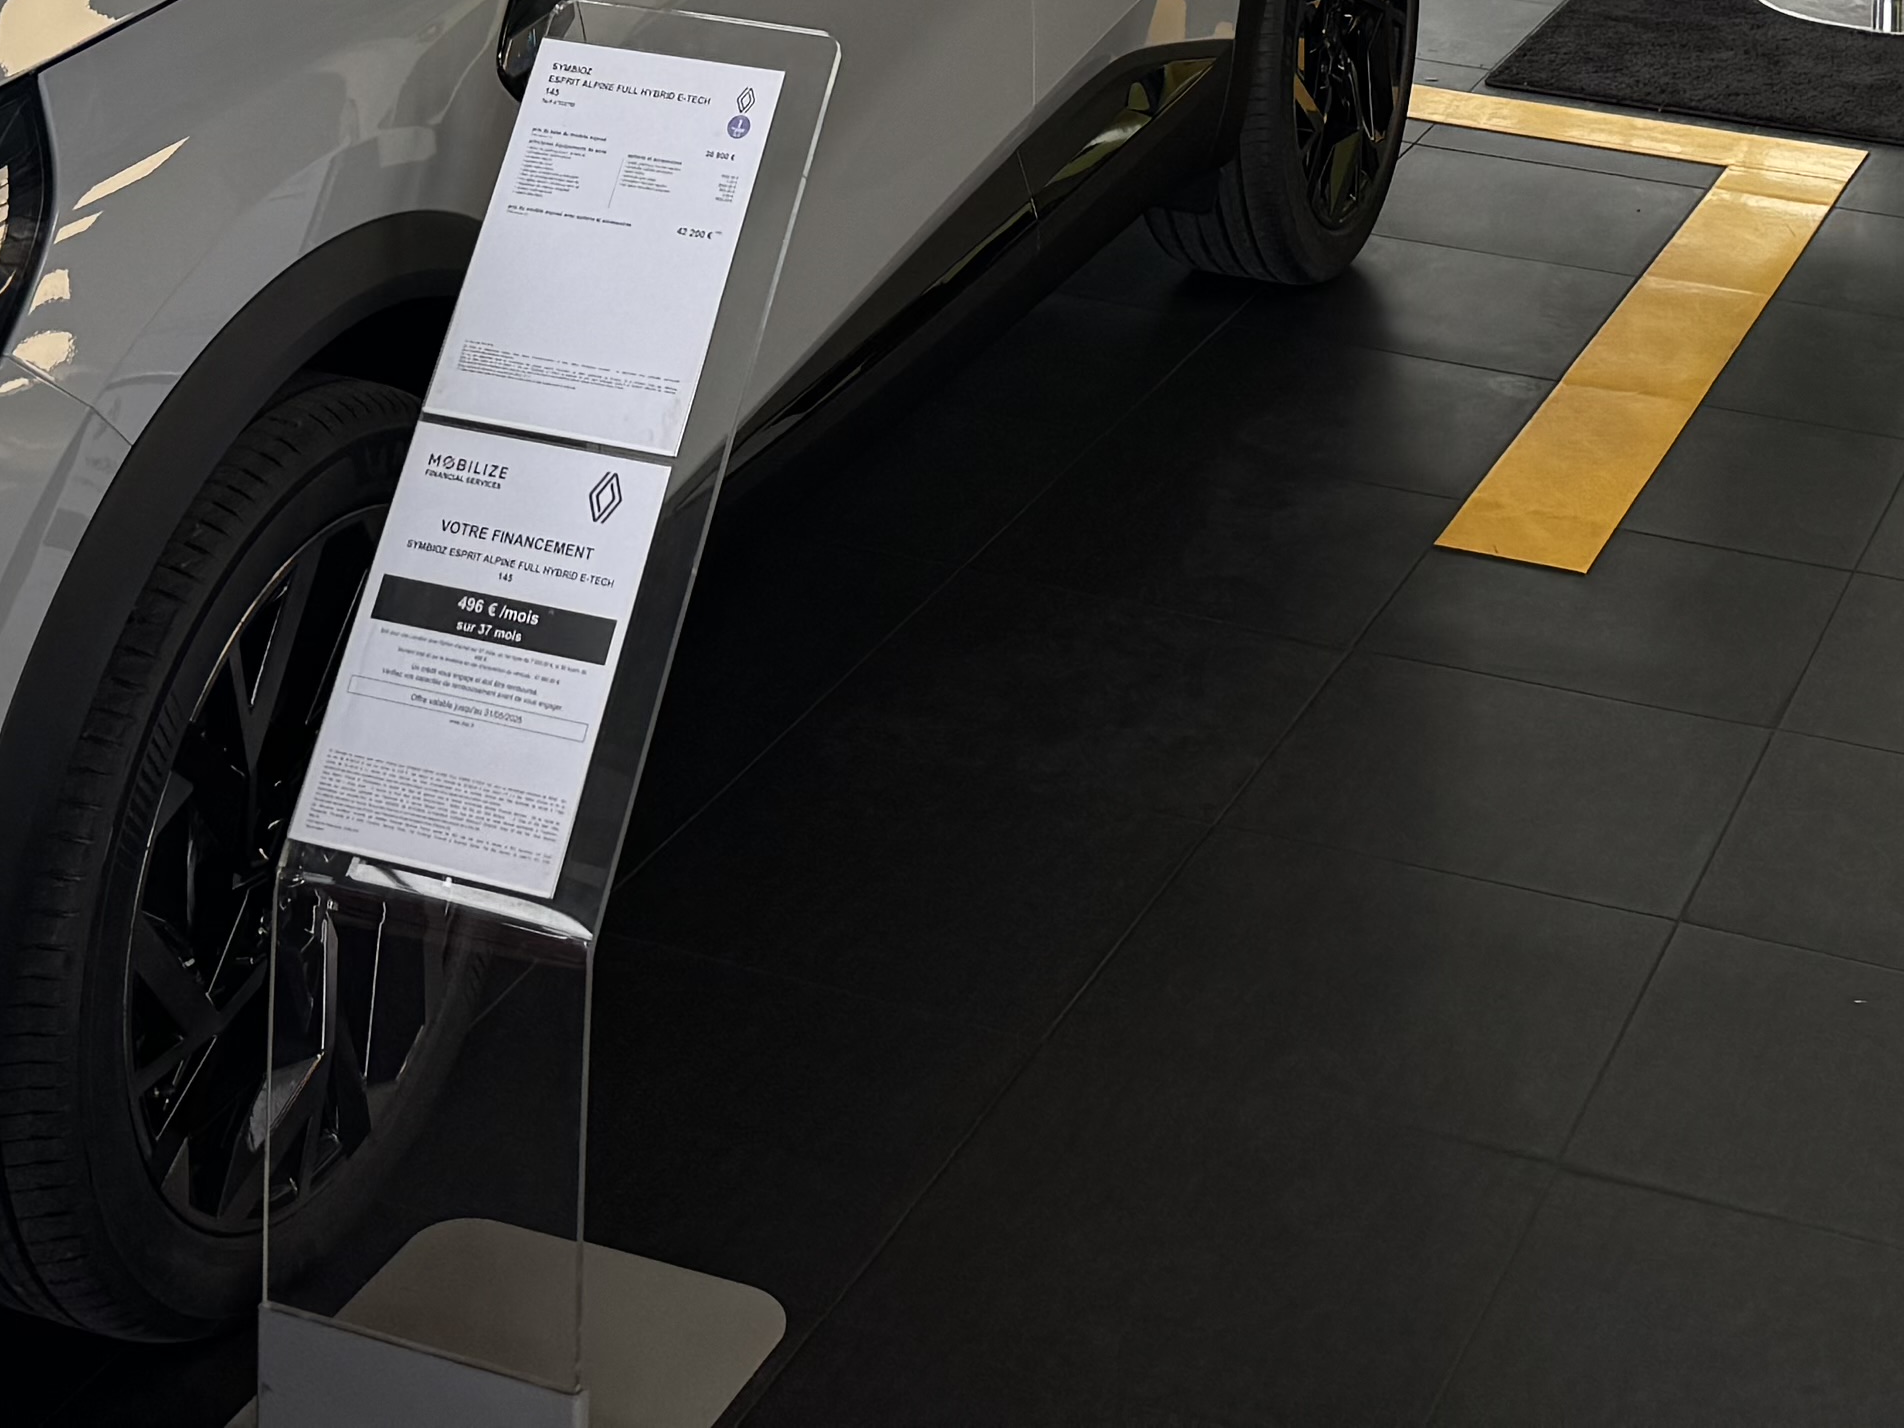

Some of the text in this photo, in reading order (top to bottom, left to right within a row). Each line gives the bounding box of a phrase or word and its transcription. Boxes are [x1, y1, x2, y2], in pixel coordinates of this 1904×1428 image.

[548, 75, 580, 87] ESPRIT
[616, 84, 639, 96] FULL
[677, 93, 711, 105] E-TECH
[441, 519, 595, 561] VOTRE FINANCEMENT
[449, 547, 481, 562] ESPRIT
[518, 561, 541, 574] FULL
[542, 566, 578, 581] HYBRID
[580, 574, 615, 588] E-TECH
[498, 572, 513, 583] 145
[457, 595, 540, 626] 496 € /mois
[456, 620, 522, 642] sur 37 mois
[410, 693, 428, 705] Offre
